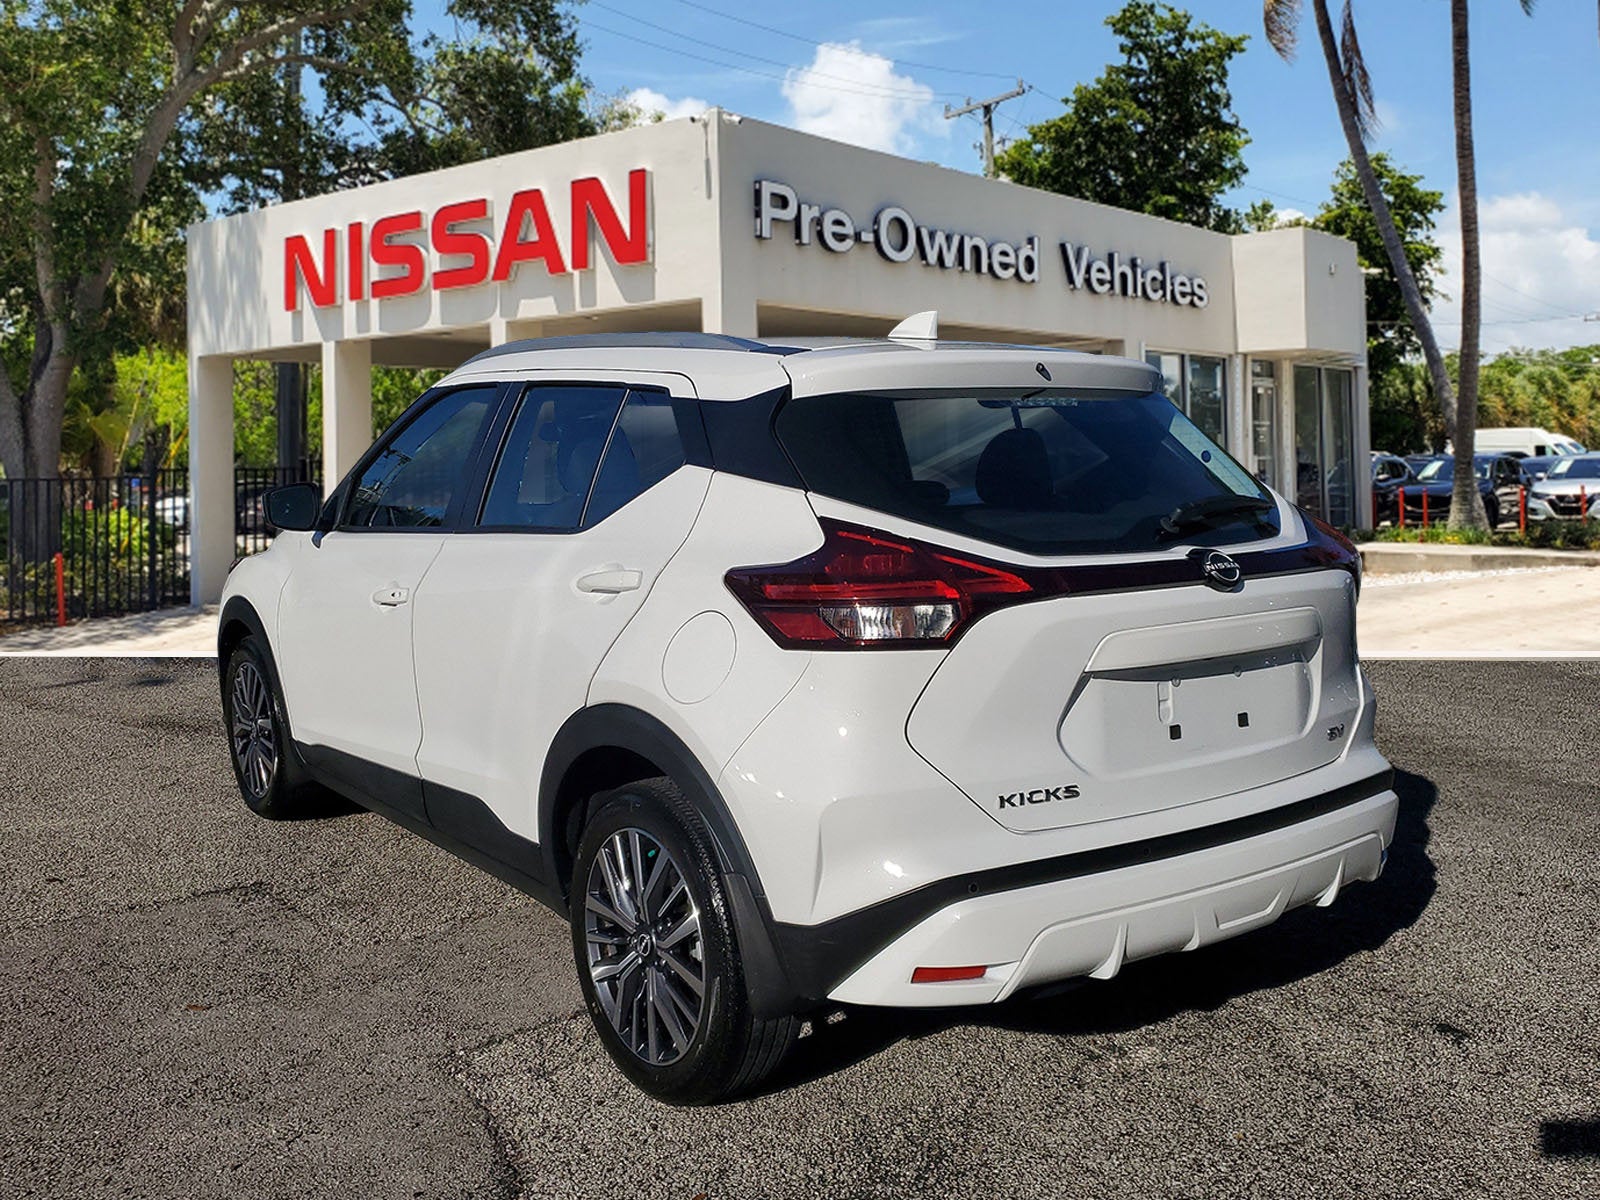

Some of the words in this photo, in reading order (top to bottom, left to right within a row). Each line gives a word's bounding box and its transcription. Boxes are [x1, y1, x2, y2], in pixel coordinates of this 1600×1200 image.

[285, 168, 650, 311] NISSAN
[755, 180, 1040, 283] Pre-Owned
[1061, 241, 1209, 308] Vehicles
[1327, 723, 1345, 742] SV
[998, 784, 1081, 809] KICKS
